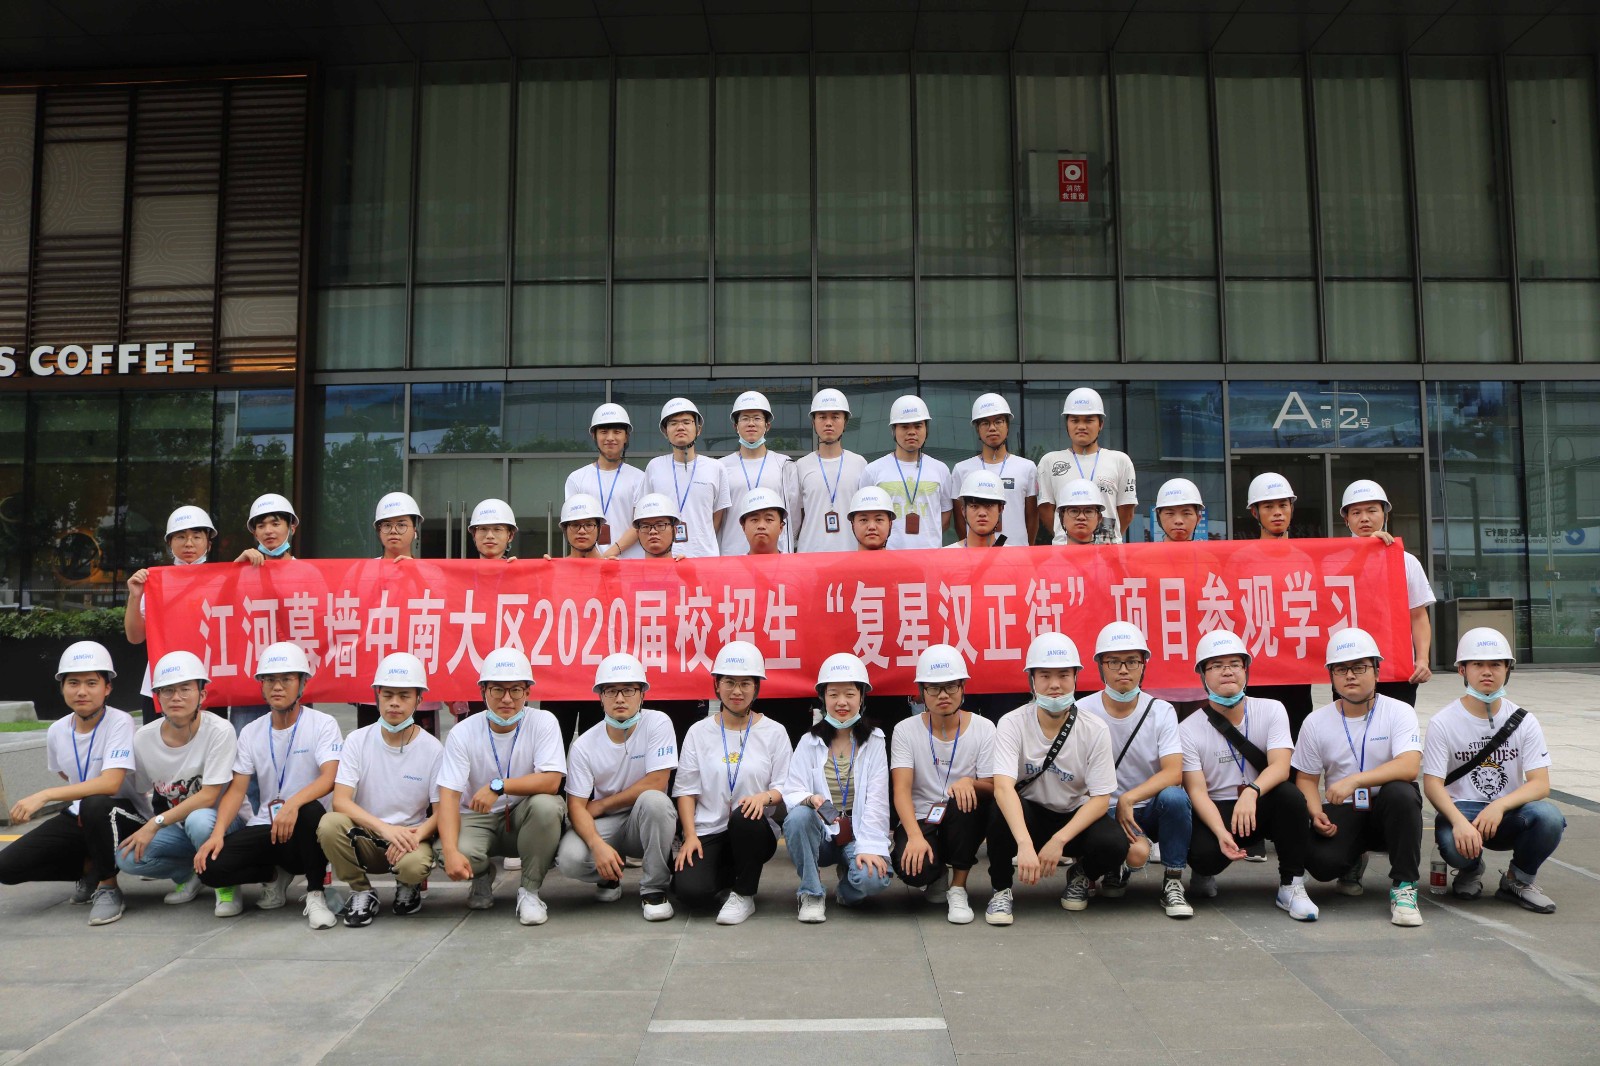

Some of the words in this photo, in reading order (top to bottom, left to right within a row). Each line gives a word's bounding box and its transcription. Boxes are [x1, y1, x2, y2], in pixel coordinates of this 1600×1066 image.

[1066, 184, 1081, 192] 消防
[30, 342, 196, 376] COFFEE
[1337, 643, 1355, 651] JANGHO
[161, 665, 180, 675] JANGHO
[930, 662, 949, 670] JANGHO
